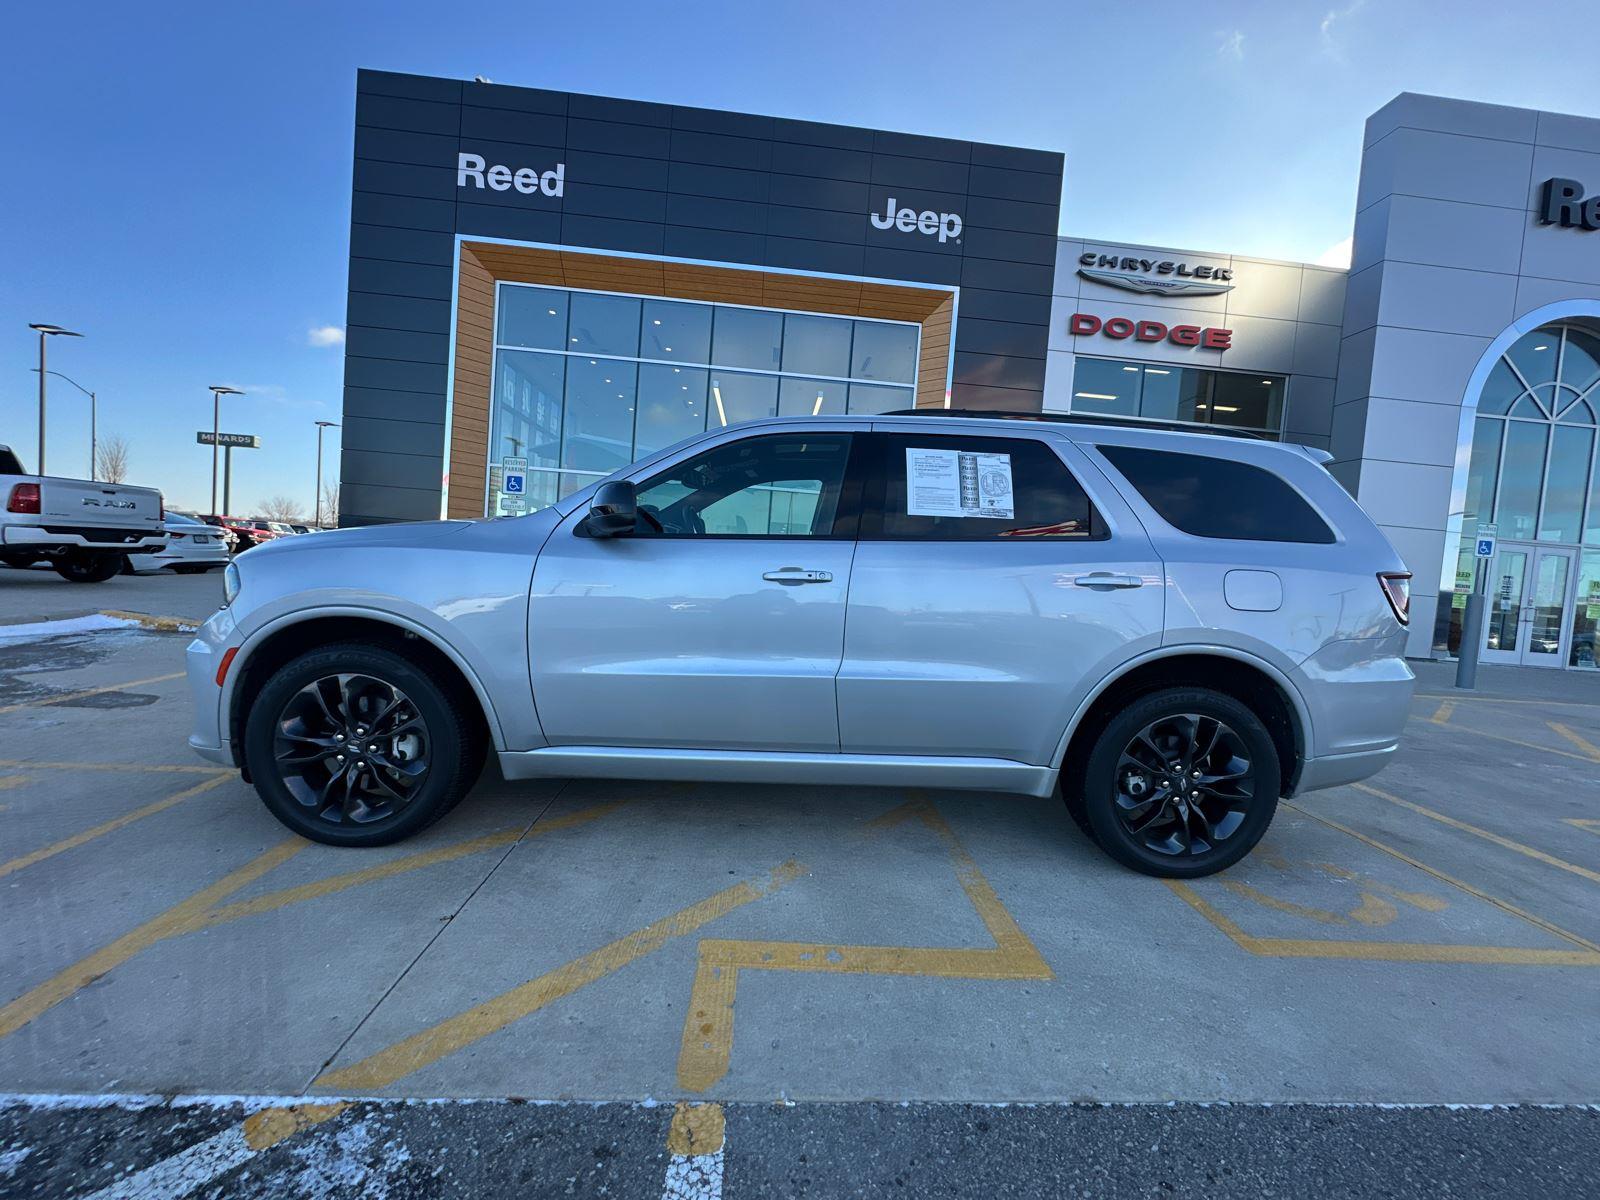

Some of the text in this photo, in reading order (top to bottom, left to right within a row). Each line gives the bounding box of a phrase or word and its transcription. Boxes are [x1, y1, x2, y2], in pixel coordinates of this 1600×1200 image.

[457, 152, 565, 198] Reed
[870, 197, 963, 243] Jeep
[1079, 252, 1234, 281] CHRYSLER
[1069, 313, 1233, 351] DODGE
[81, 497, 136, 510] RAM
